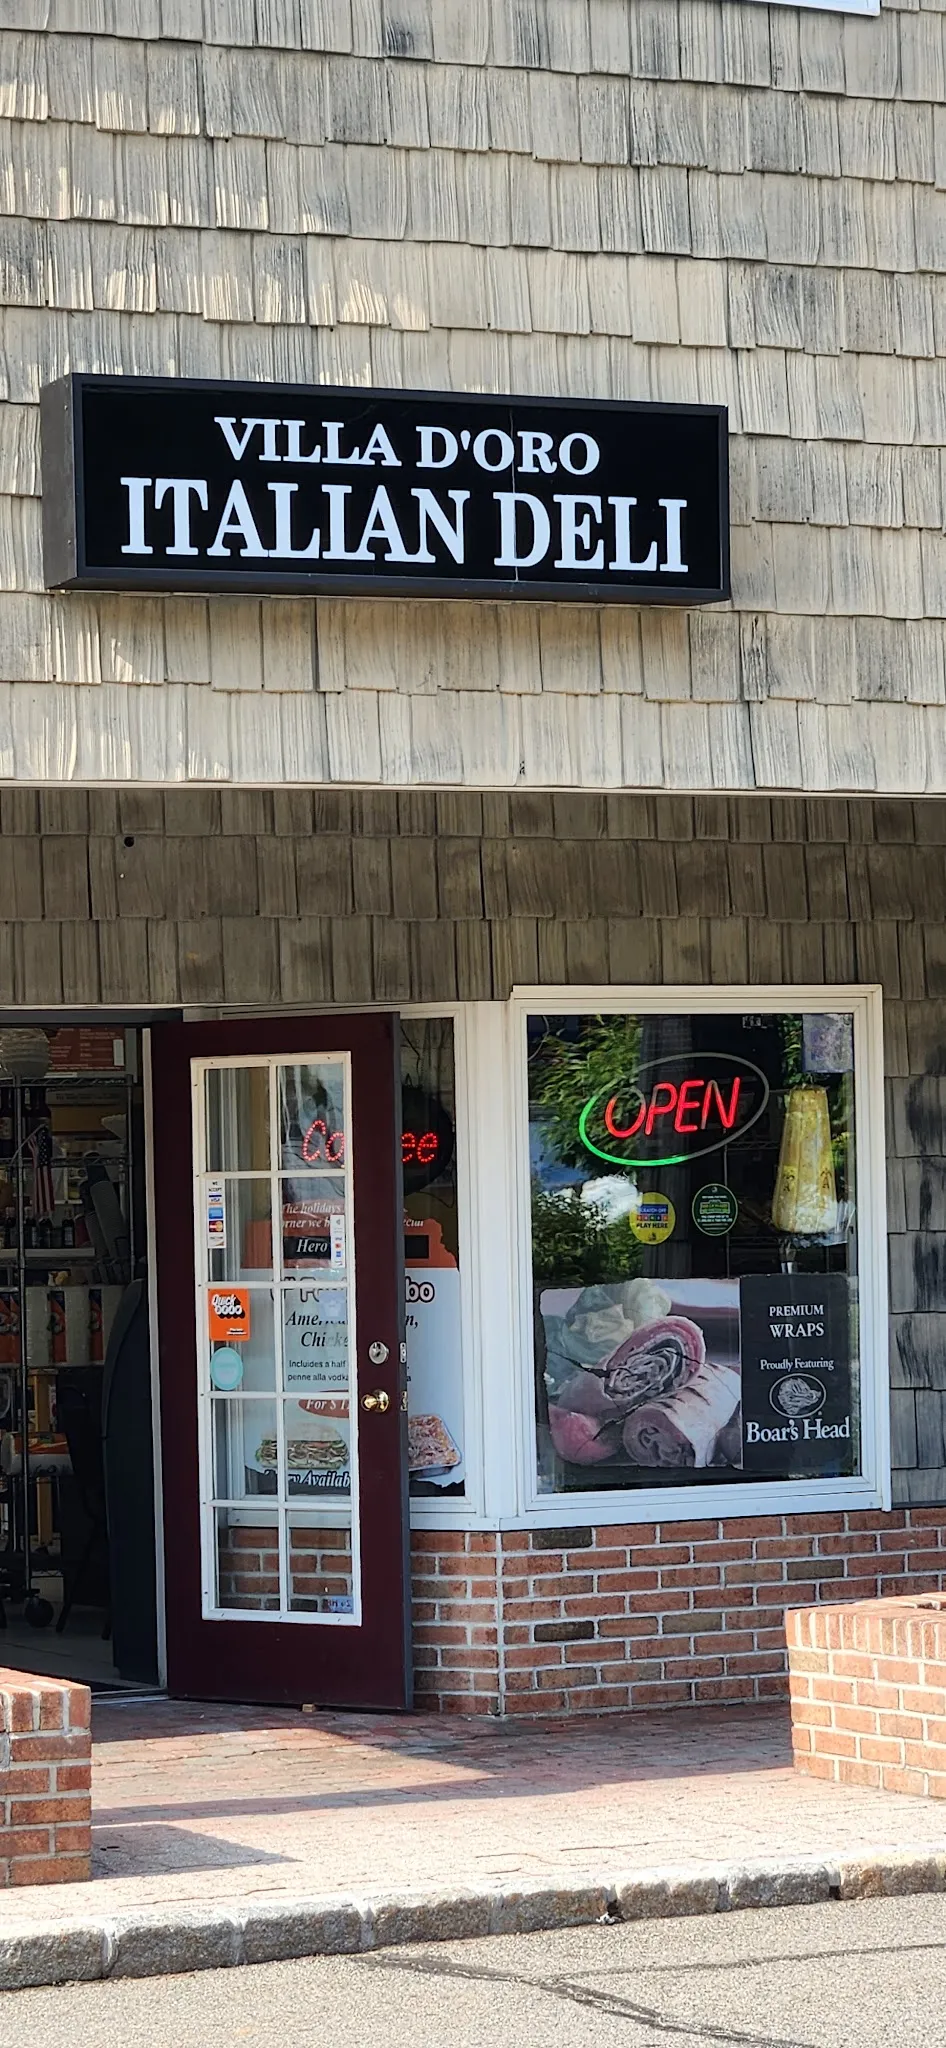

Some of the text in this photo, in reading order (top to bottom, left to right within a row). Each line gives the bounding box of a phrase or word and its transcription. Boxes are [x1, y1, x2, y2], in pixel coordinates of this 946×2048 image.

[214, 416, 600, 475] VILLA D'ORO
[120, 477, 689, 573] ITALIAN DELI
[604, 1077, 740, 1138] OPEN
[299, 1202, 341, 1214] holidays
[284, 1220, 306, 1228] rner
[296, 1238, 328, 1253] Hero
[769, 1304, 824, 1317] PREMIUM
[769, 1322, 824, 1338] WRAPS
[760, 1357, 834, 1372] Proudly Featuring
[288, 1374, 311, 1382] penne
[746, 1416, 850, 1443] Boar's Head
[302, 1470, 350, 1488] Availab
